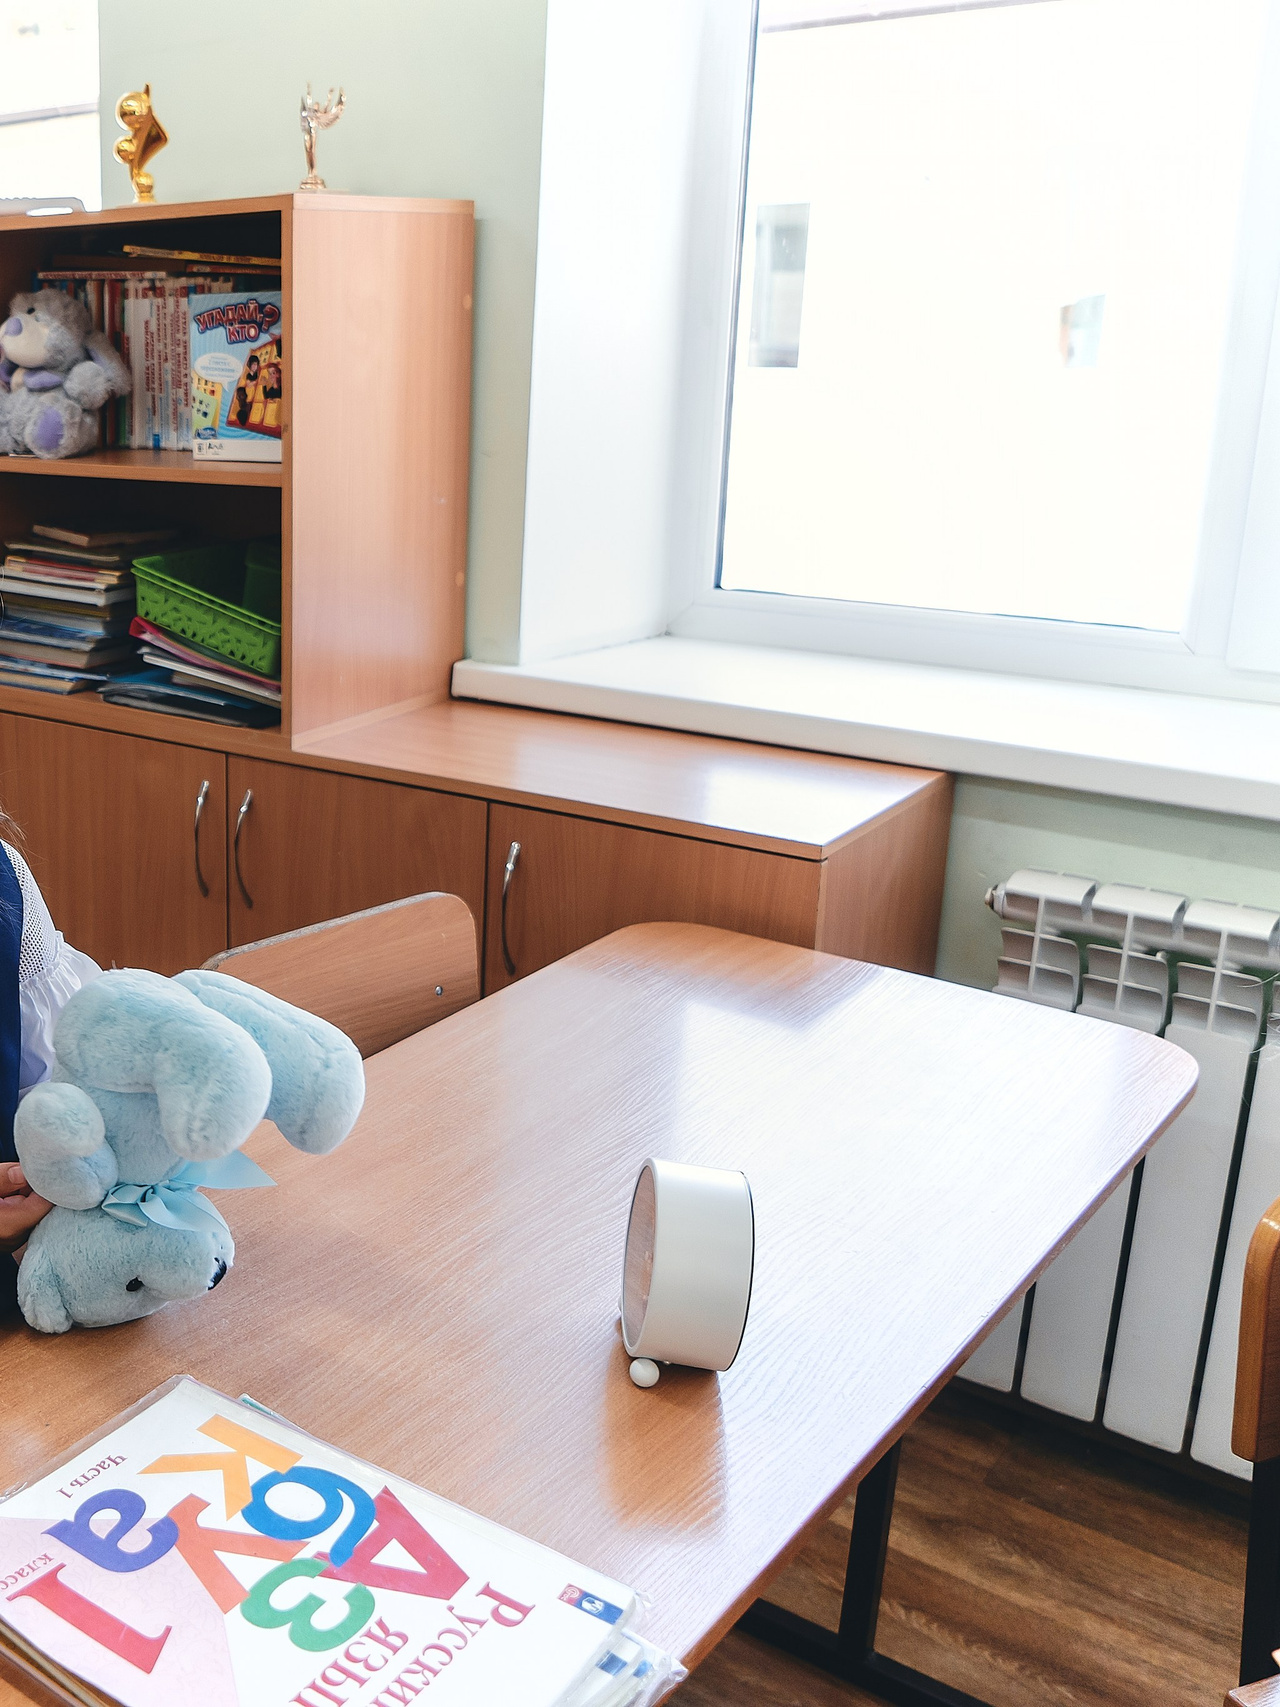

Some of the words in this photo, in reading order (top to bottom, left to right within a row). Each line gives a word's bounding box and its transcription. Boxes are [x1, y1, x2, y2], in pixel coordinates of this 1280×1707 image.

[56, 1486, 74, 1499] 1
[70, 1454, 128, 1489] Часть
[5, 1562, 173, 1675] 1
[369, 1581, 536, 1707] Русски
